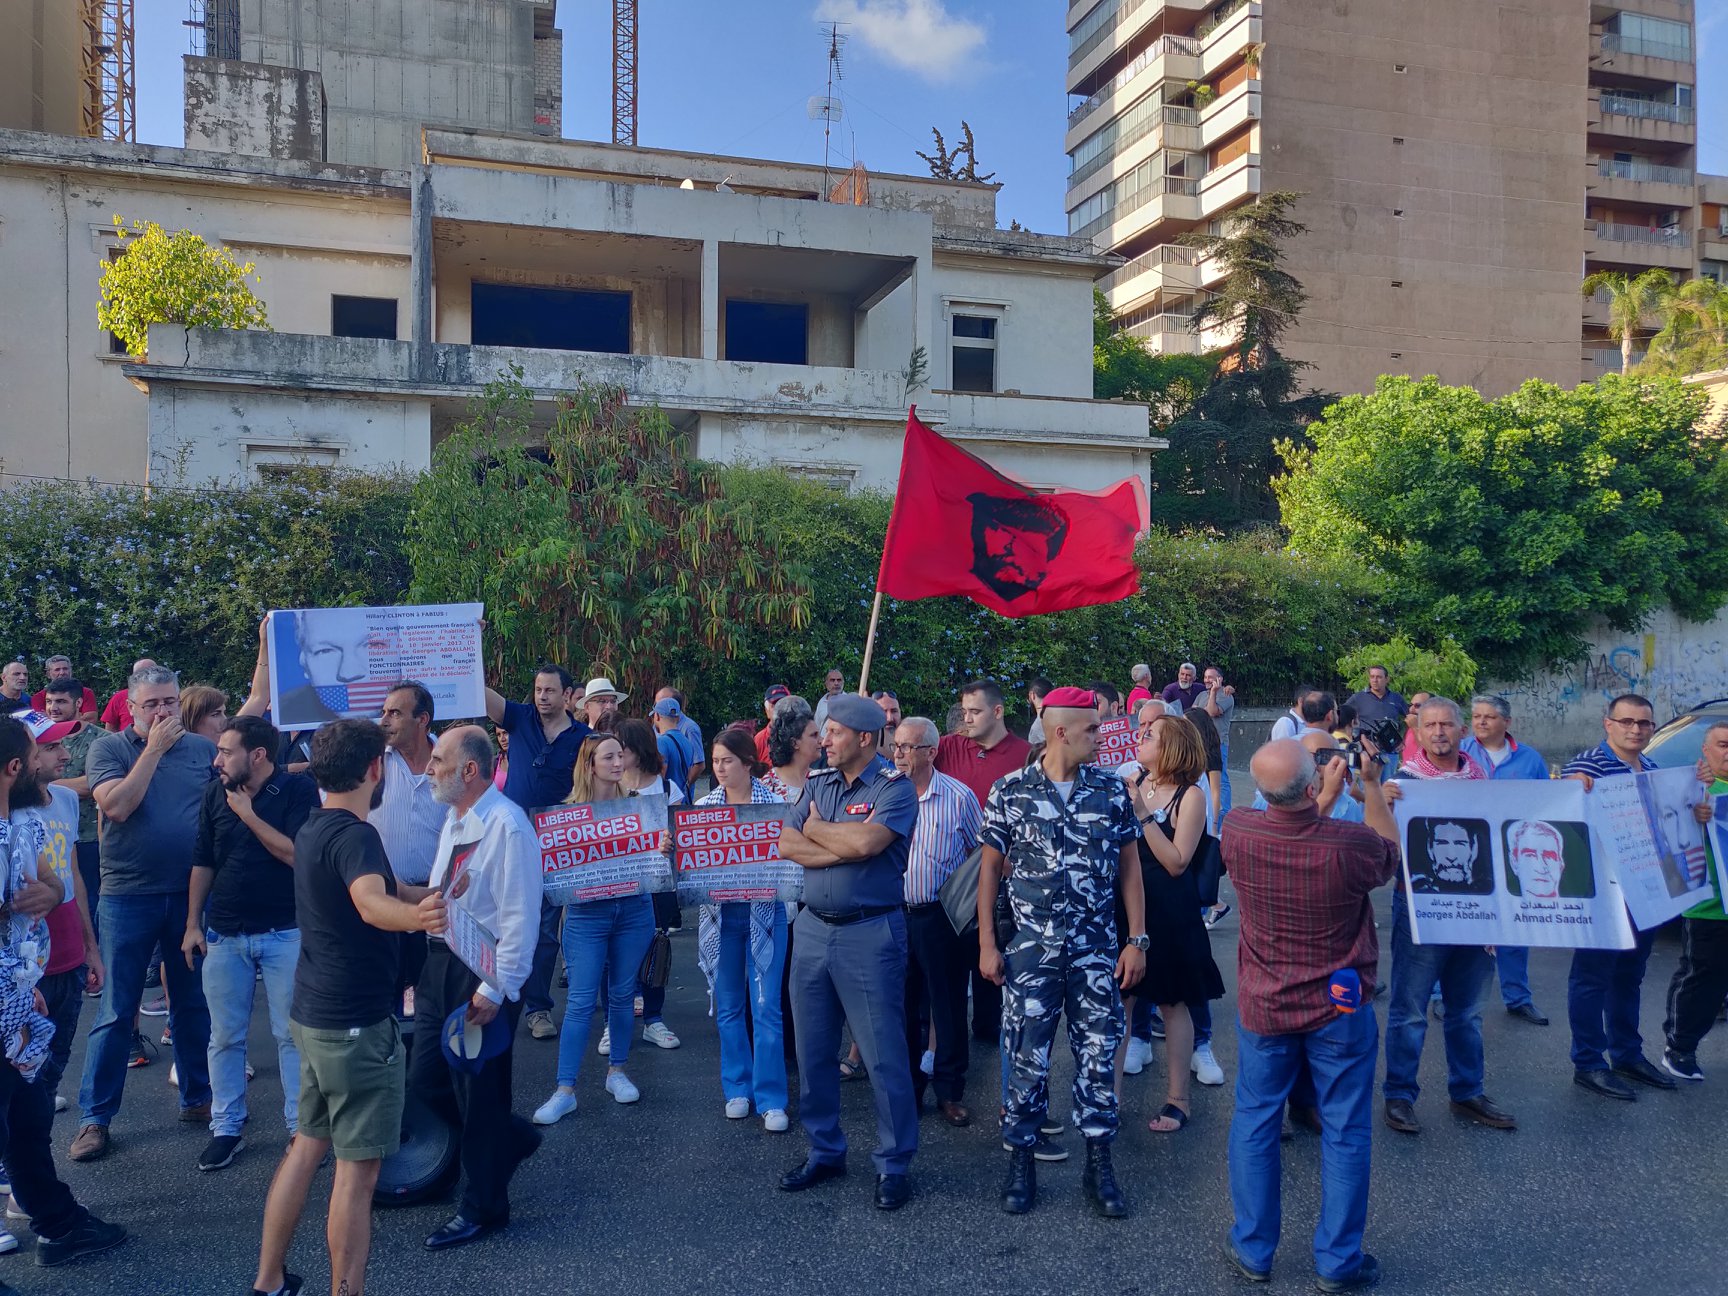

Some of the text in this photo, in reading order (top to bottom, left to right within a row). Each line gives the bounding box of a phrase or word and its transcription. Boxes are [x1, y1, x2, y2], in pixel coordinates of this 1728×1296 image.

[1100, 720, 1126, 734] ÉREZ
[538, 808, 589, 828] LIBÉREZ
[678, 810, 732, 826] LIBÉREZ
[538, 815, 639, 850] GEORGES
[678, 821, 781, 847] GEORGES
[543, 833, 655, 873] ABDALLAH
[680, 843, 781, 870] ABDALLA
[1416, 910, 1497, 921] Georges Abdallah
[1513, 913, 1593, 925] Ahmad Saadat
